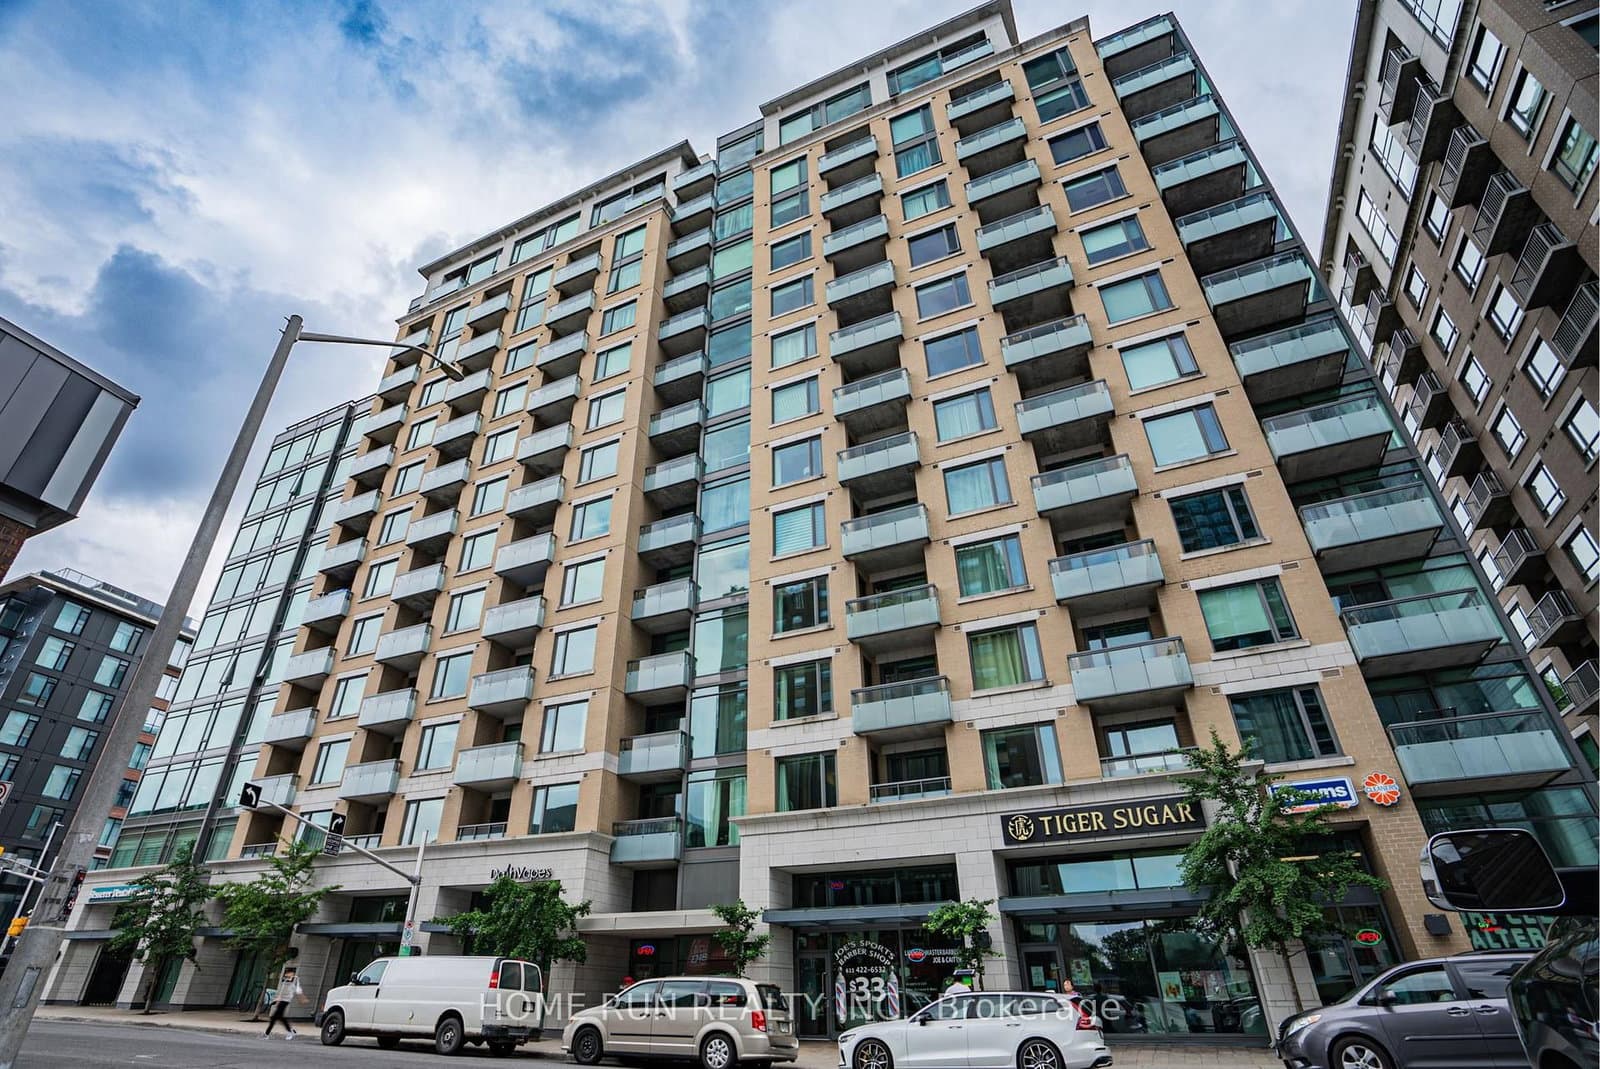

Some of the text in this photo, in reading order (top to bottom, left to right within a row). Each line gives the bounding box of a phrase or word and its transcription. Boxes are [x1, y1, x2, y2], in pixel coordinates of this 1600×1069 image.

[1039, 803, 1196, 836] TIGER SUGAR
[1471, 928, 1546, 949] ALTER
[834, 939, 896, 961] JOE'S SPORTS
[838, 948, 867, 966] BARBER
[868, 950, 891, 966] SHOP
[849, 976, 887, 1002] $33
